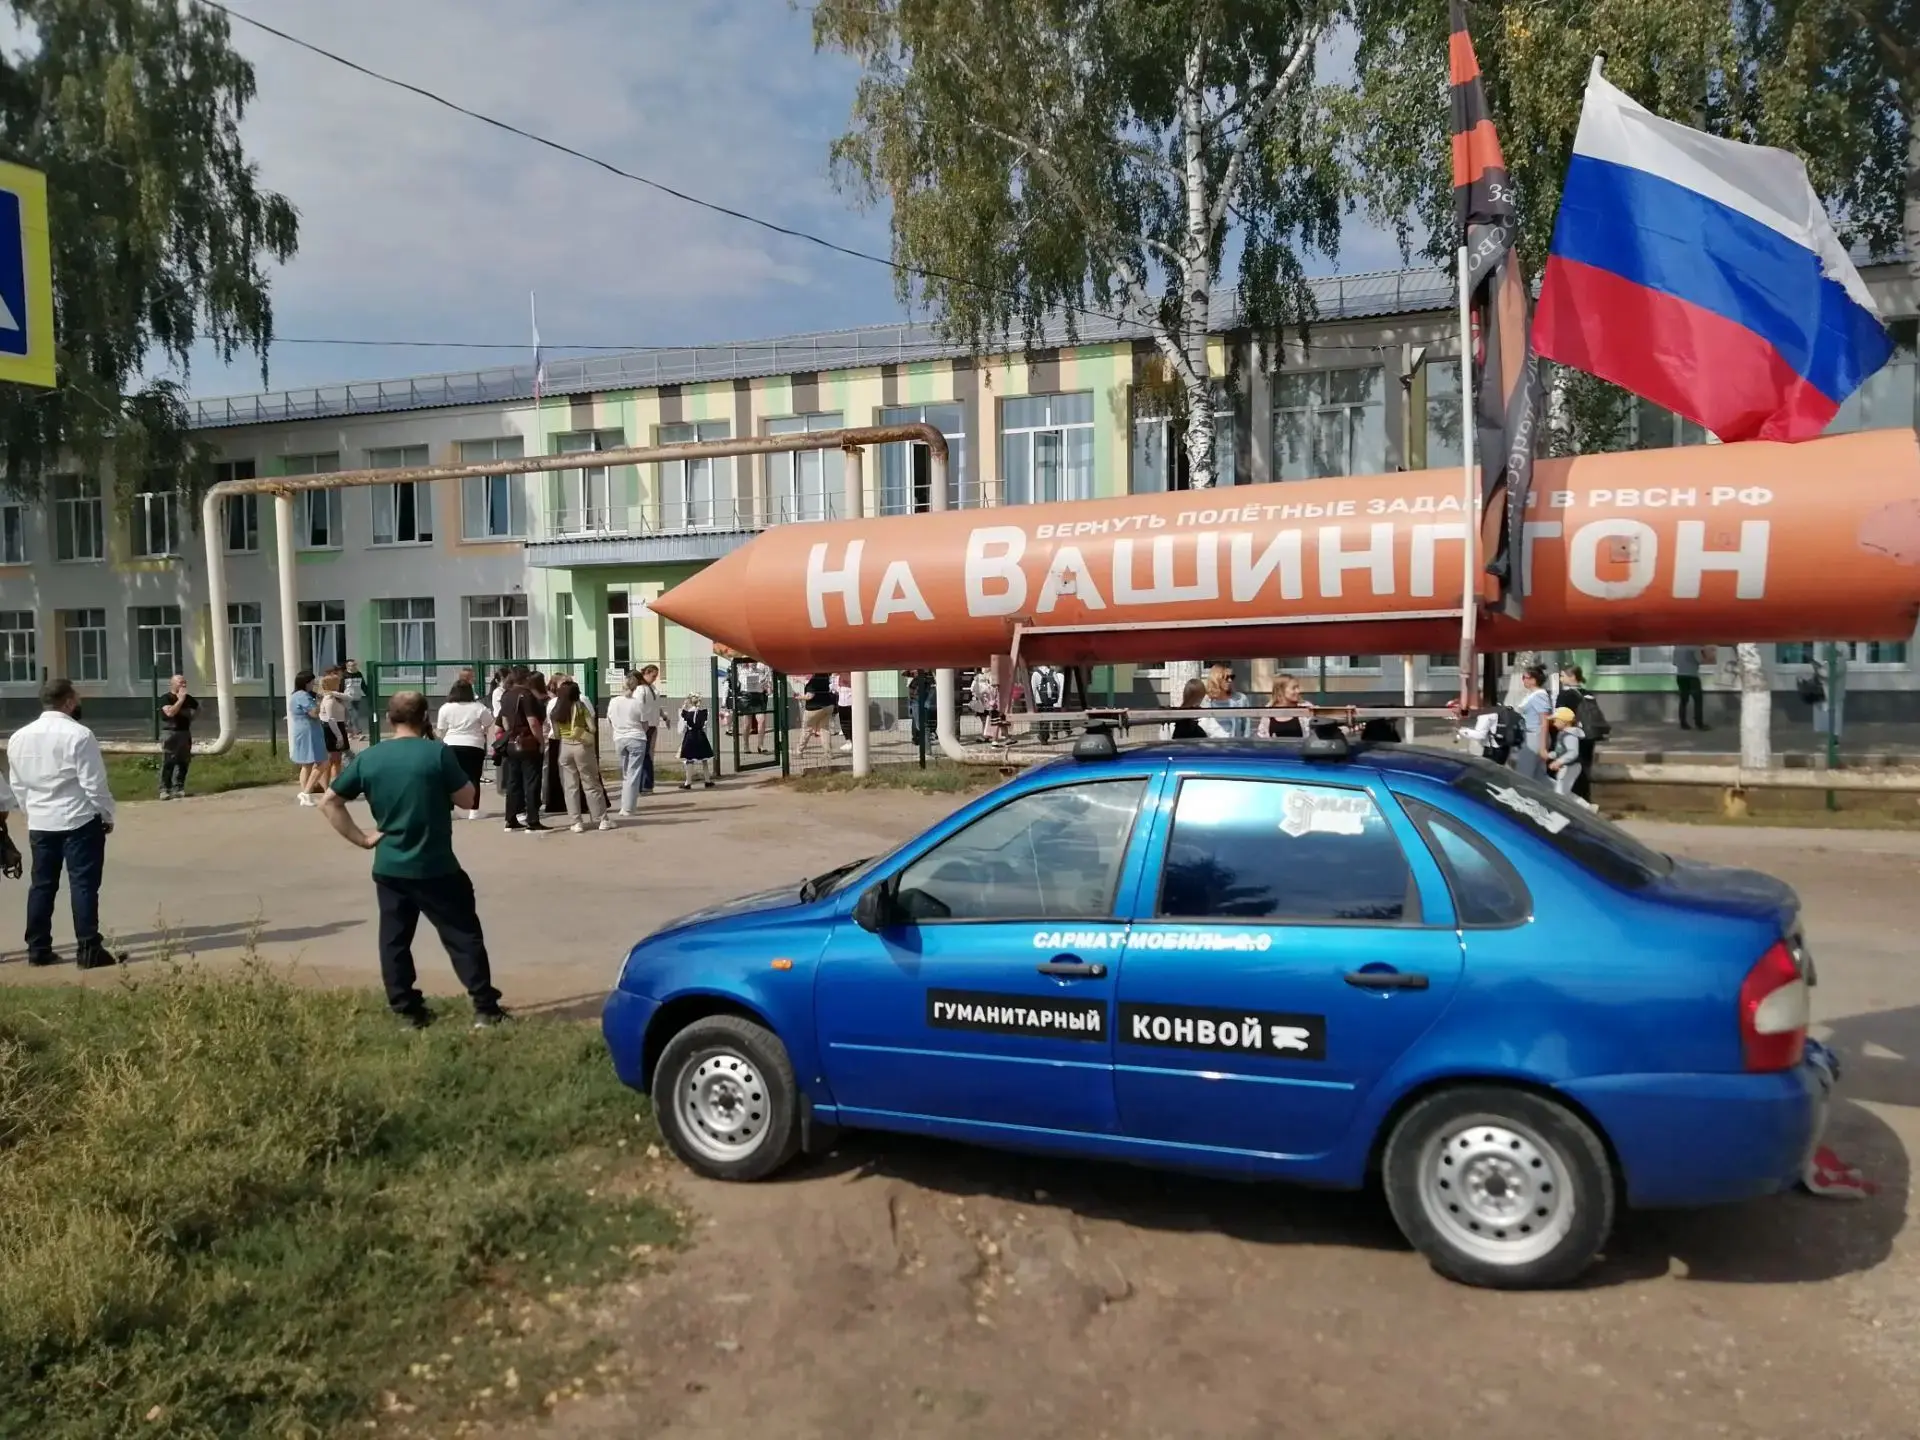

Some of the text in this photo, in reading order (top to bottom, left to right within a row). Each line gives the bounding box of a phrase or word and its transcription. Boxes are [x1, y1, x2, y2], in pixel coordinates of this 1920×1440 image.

[1036, 514, 1166, 539] ВЕРНУТЬ
[1177, 500, 1356, 526] ПОЛЁТНЫЕ
[1550, 490, 1575, 508] В
[1588, 488, 1697, 508] РВСН
[1711, 486, 1773, 506] РФ
[933, 1001, 1262, 1049] ГУМАНИТАРНЫЙ КОНВОЙ
